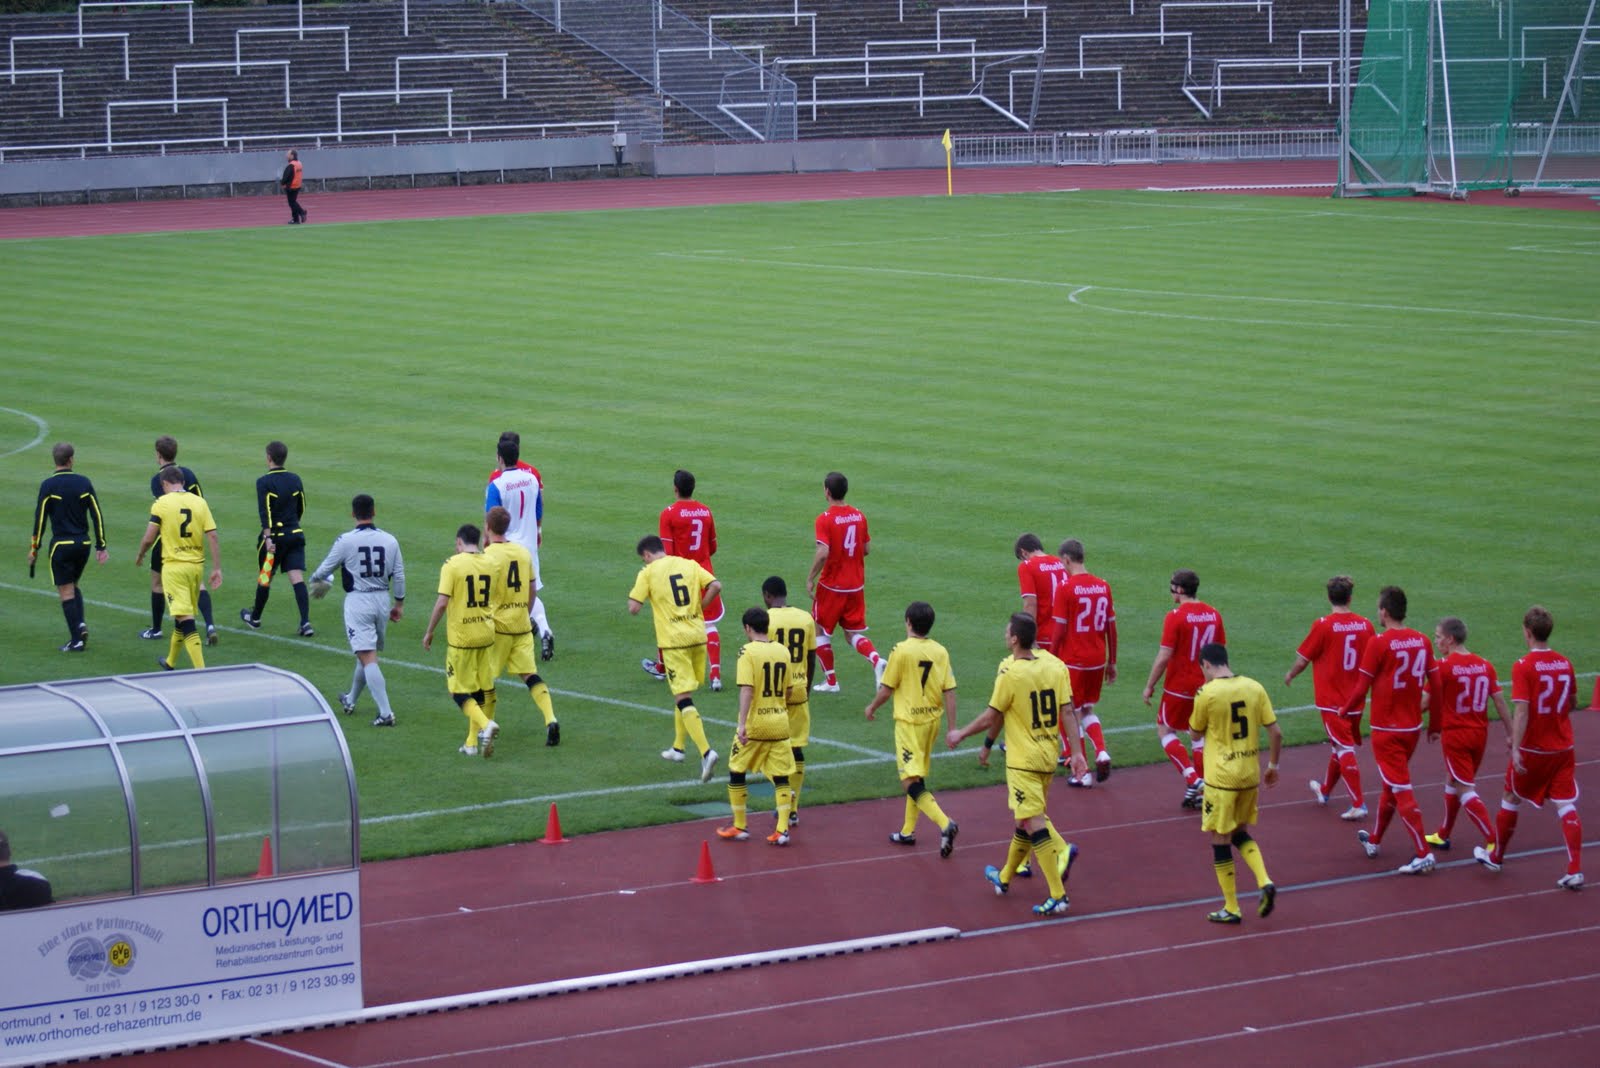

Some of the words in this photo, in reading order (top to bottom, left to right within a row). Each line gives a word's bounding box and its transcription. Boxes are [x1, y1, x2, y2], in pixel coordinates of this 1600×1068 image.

[520, 490, 525, 519] 1
[680, 508, 710, 517] düsseldorf
[835, 513, 862, 524] düsseldorf
[180, 508, 193, 537] 2
[689, 519, 703, 550] 3
[844, 525, 857, 556] 4
[358, 546, 385, 577] 33
[507, 560, 522, 592] 4
[466, 575, 491, 608] 13
[669, 573, 691, 607] 6
[1074, 585, 1107, 595] düsseldorf
[1076, 597, 1108, 632] 28
[1186, 612, 1217, 622] düsseldorf
[1332, 622, 1367, 632] düsseldorf
[775, 628, 805, 663] 18
[1343, 634, 1357, 671] 6
[1389, 638, 1425, 650] düsseldorf
[762, 662, 787, 697] 10
[918, 660, 934, 697] 7
[1392, 649, 1427, 689] 24
[1452, 664, 1487, 676] düsseldorf
[1535, 660, 1569, 671] düsseldorf
[1030, 688, 1057, 729] 19
[1455, 676, 1489, 714] 20
[1537, 674, 1570, 714] 27
[1231, 701, 1248, 740] 5
[202, 892, 353, 937] ORTHOMED
[37, 935, 61, 958] Eine
[61, 920, 93, 941] starke
[96, 917, 164, 944] Partnerschaft
[112, 944, 130, 961] BVB
[215, 940, 276, 956] Medizinisches
[279, 933, 323, 948] Leistungs-
[326, 930, 343, 942] und
[215, 949, 314, 969] Rehabilitationszentrum
[315, 944, 344, 957] GmbH
[0, 1012, 52, 1031] ortmund
[73, 1008, 93, 1022] Tel.
[96, 1006, 111, 1018] 02
[114, 1003, 128, 1016] 31
[139, 1000, 147, 1013] 9
[151, 997, 172, 1010] 123
[174, 993, 201, 1008] 30-0
[221, 988, 245, 1001] Fax:
[248, 985, 263, 998] 02
[265, 983, 279, 995] 31
[289, 979, 297, 992] 9
[301, 976, 321, 990] 123
[324, 972, 356, 988] 30-99
[4, 1009, 202, 1047] www.orthomed-rehazentrum.de
